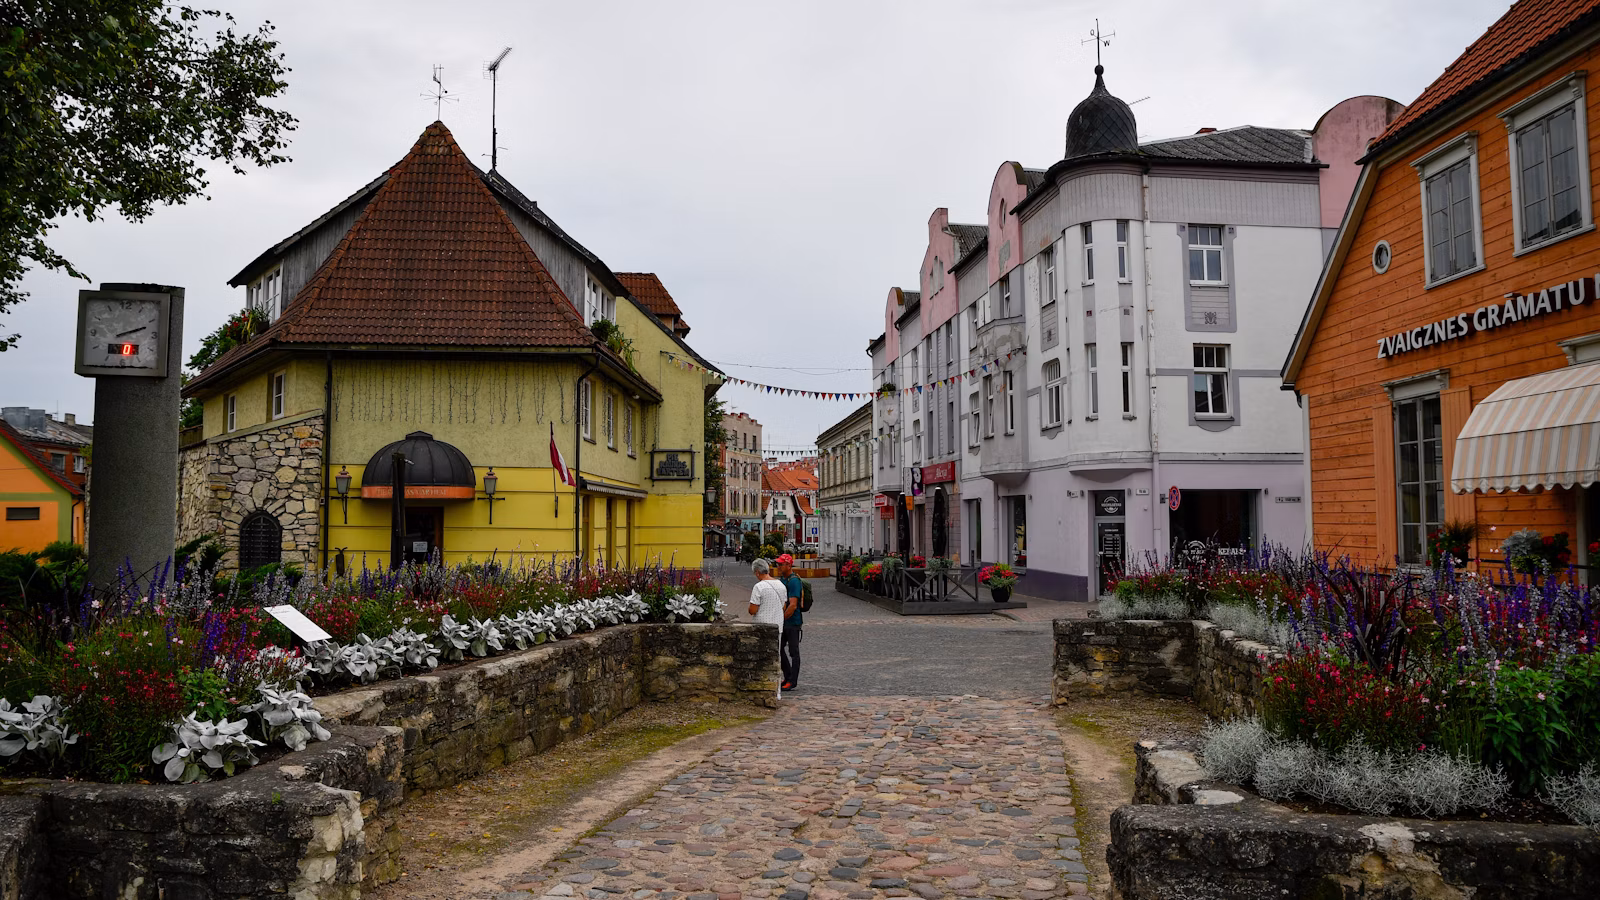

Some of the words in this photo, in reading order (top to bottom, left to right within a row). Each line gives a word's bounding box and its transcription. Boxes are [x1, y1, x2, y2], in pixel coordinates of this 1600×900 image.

[120, 302, 132, 310] 12
[1377, 313, 1469, 359] ZVAIGZNES
[1473, 277, 1586, 331] GRĀMATU
[90, 329, 97, 337] 9
[151, 331, 158, 339] 3
[123, 344, 131, 355] 0
[120, 358, 126, 367] 6
